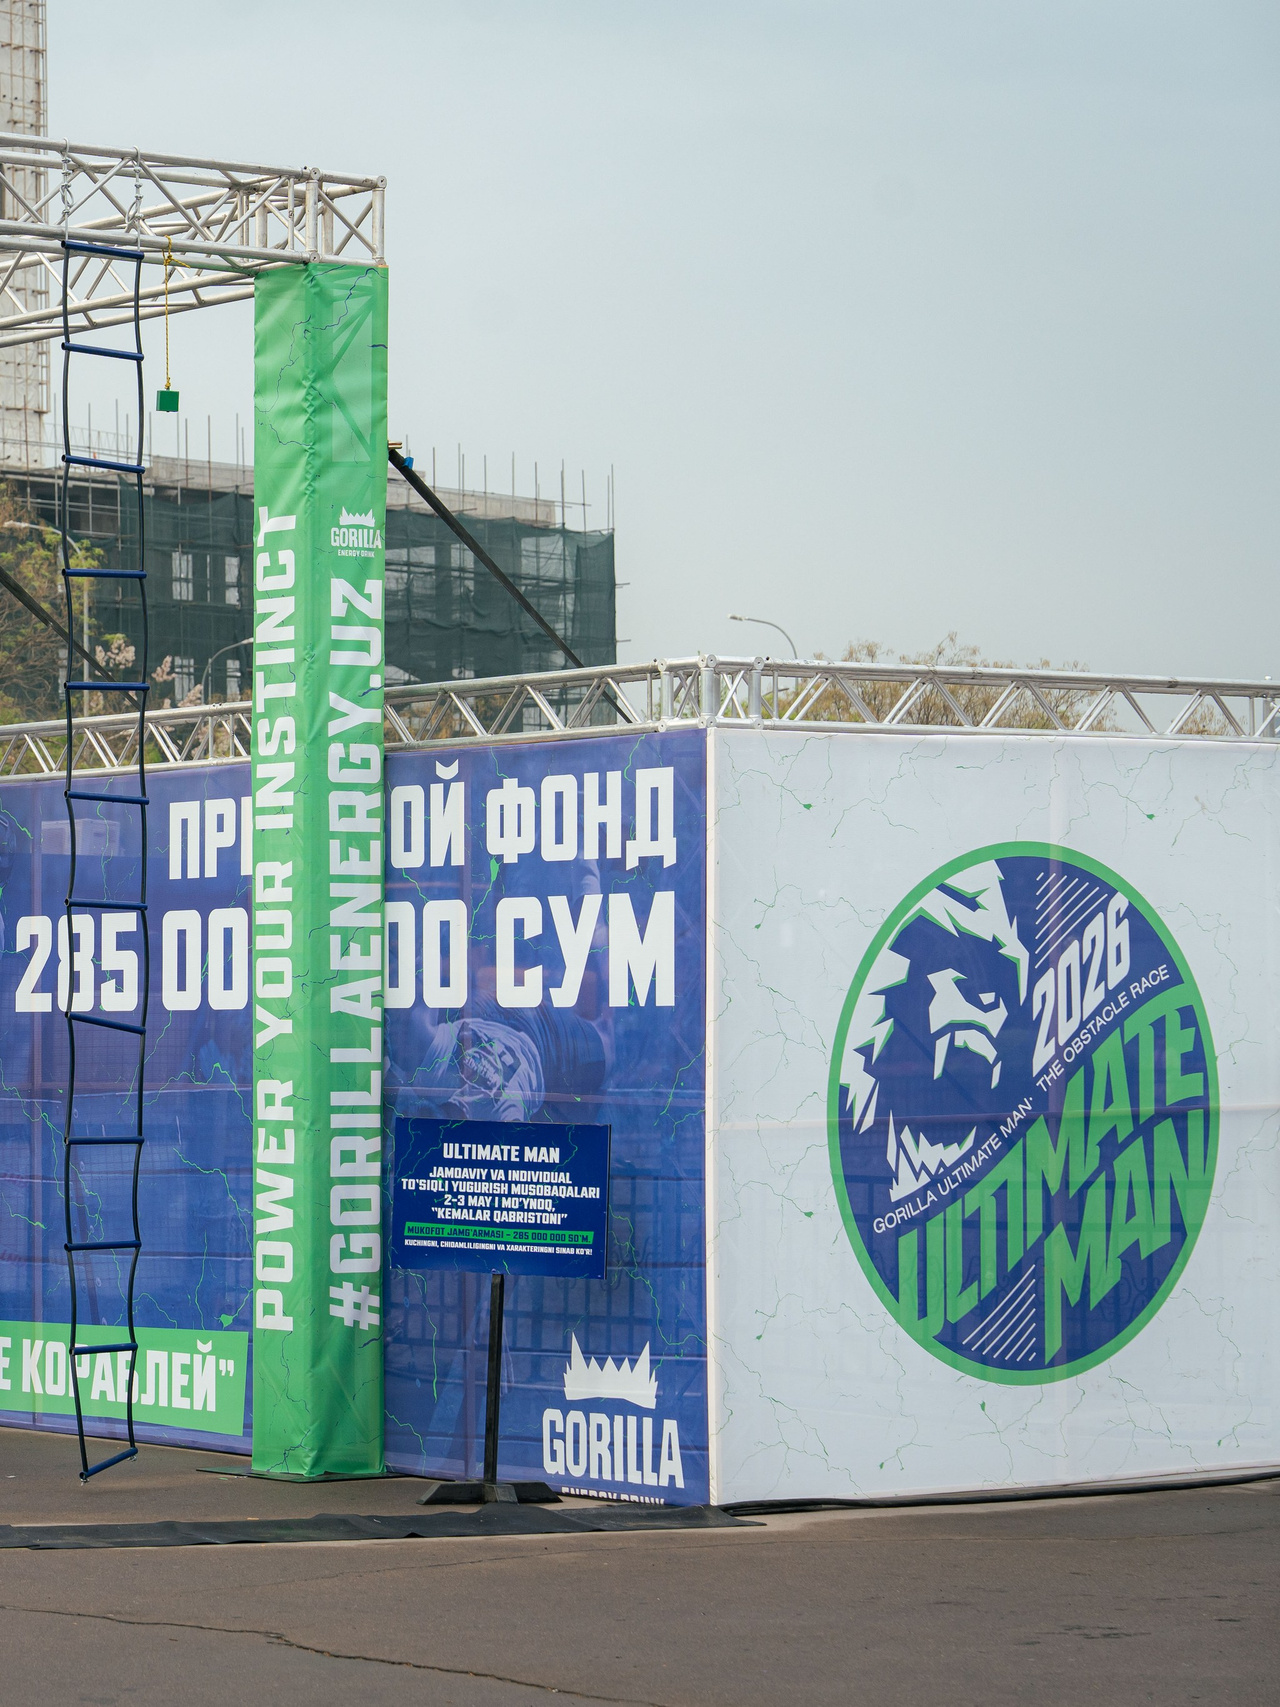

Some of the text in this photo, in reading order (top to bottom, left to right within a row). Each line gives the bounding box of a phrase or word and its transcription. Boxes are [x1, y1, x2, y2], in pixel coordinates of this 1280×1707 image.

[332, 527, 382, 549] GORILLA
[338, 549, 360, 557] ENERGY
[486, 766, 677, 870] ФОНД
[255, 506, 297, 1331] POWER YOUR INSTINCT
[15, 891, 676, 1013] 285 00 00 СУМ
[328, 576, 382, 1331] #GORILLAENERGY.UZ
[1032, 892, 1131, 1077] 2026
[873, 1190, 938, 1234] GORILLA
[938, 1134, 1002, 1193] ULTIMATE
[1036, 1061, 1066, 1092] THE
[1062, 993, 1130, 1065] OBSTACLE
[1129, 965, 1170, 999] RACE
[429, 1166, 572, 1184] JAMOAVIY VA INDIVIDUAL
[443, 1142, 560, 1163] ULTIMATE MAN
[898, 1003, 1205, 1339] ULTIMATE
[402, 1178, 600, 1199] TO'SIQLI YUGURISH MUSOBAQALARI
[444, 1195, 465, 1206] 2-3
[469, 1196, 492, 1208] MAY
[407, 1225, 445, 1236] MUKOFOT
[513, 1231, 530, 1240] 285
[532, 1231, 547, 1241] 000
[549, 1232, 566, 1242] 000
[431, 1207, 568, 1225] "KEMALAR QABRISTONI"
[1044, 1107, 1209, 1365] MAN
[497, 1243, 505, 1251] VA
[506, 1243, 555, 1254] XARAKTERINGNI
[543, 1408, 685, 1489] GORILLA
